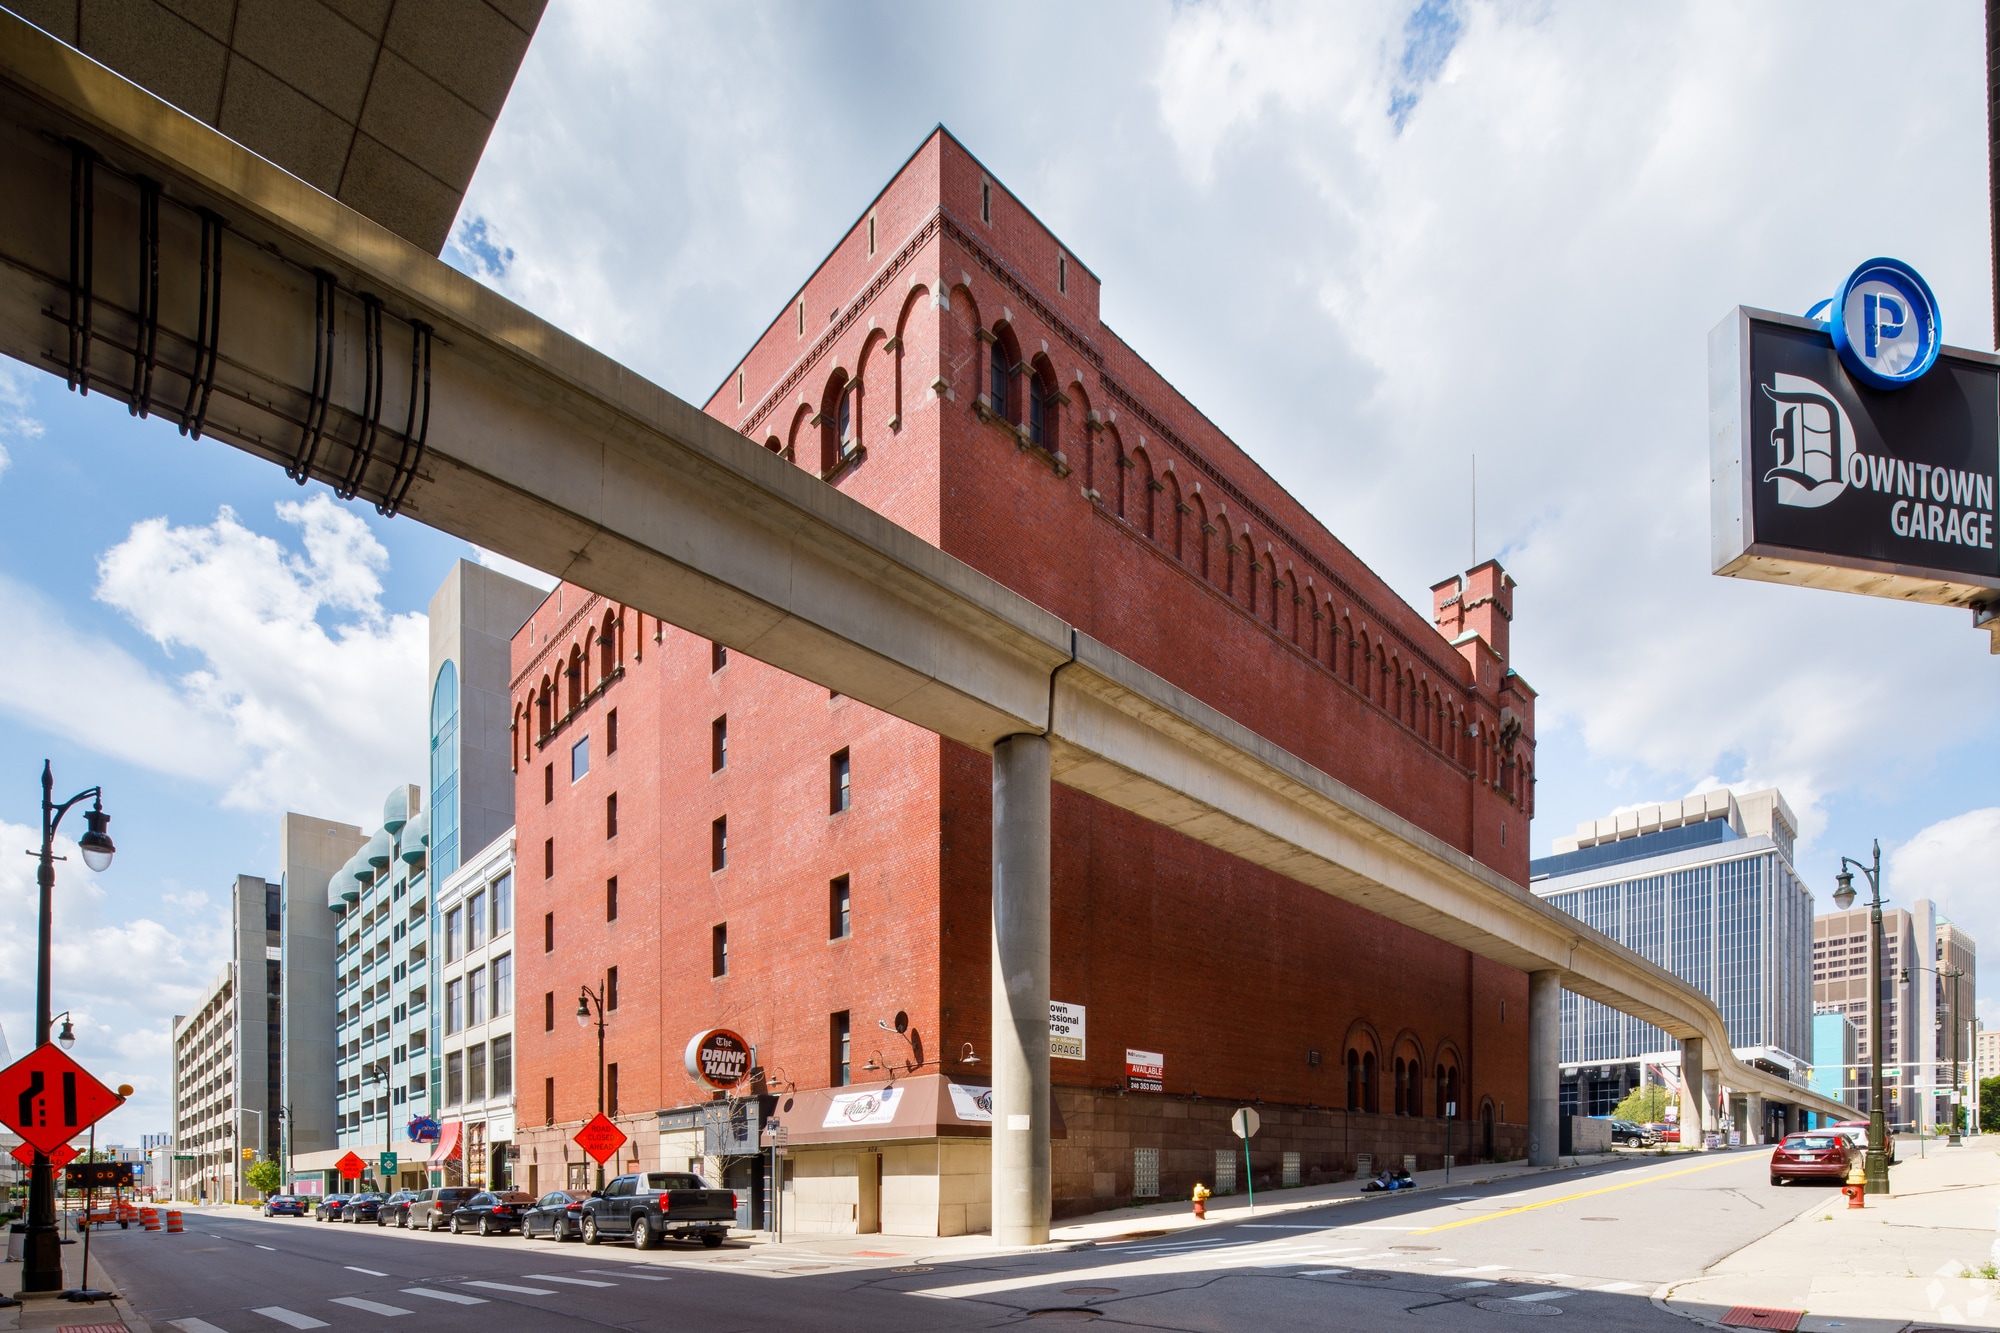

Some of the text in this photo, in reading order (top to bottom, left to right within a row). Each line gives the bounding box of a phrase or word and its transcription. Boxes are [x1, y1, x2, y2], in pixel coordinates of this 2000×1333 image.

[1864, 292, 1909, 358] P
[1891, 500, 1993, 550] GARAGE
[715, 1036, 733, 1048] The
[701, 1048, 747, 1064] DRINK
[705, 1061, 743, 1077] HALL
[1132, 1064, 1163, 1076] AVAILABLE
[1140, 1082, 1150, 1091] 353
[1150, 1084, 1163, 1092] 0500
[591, 1125, 611, 1133] ROAD
[587, 1133, 615, 1141] CLOSED
